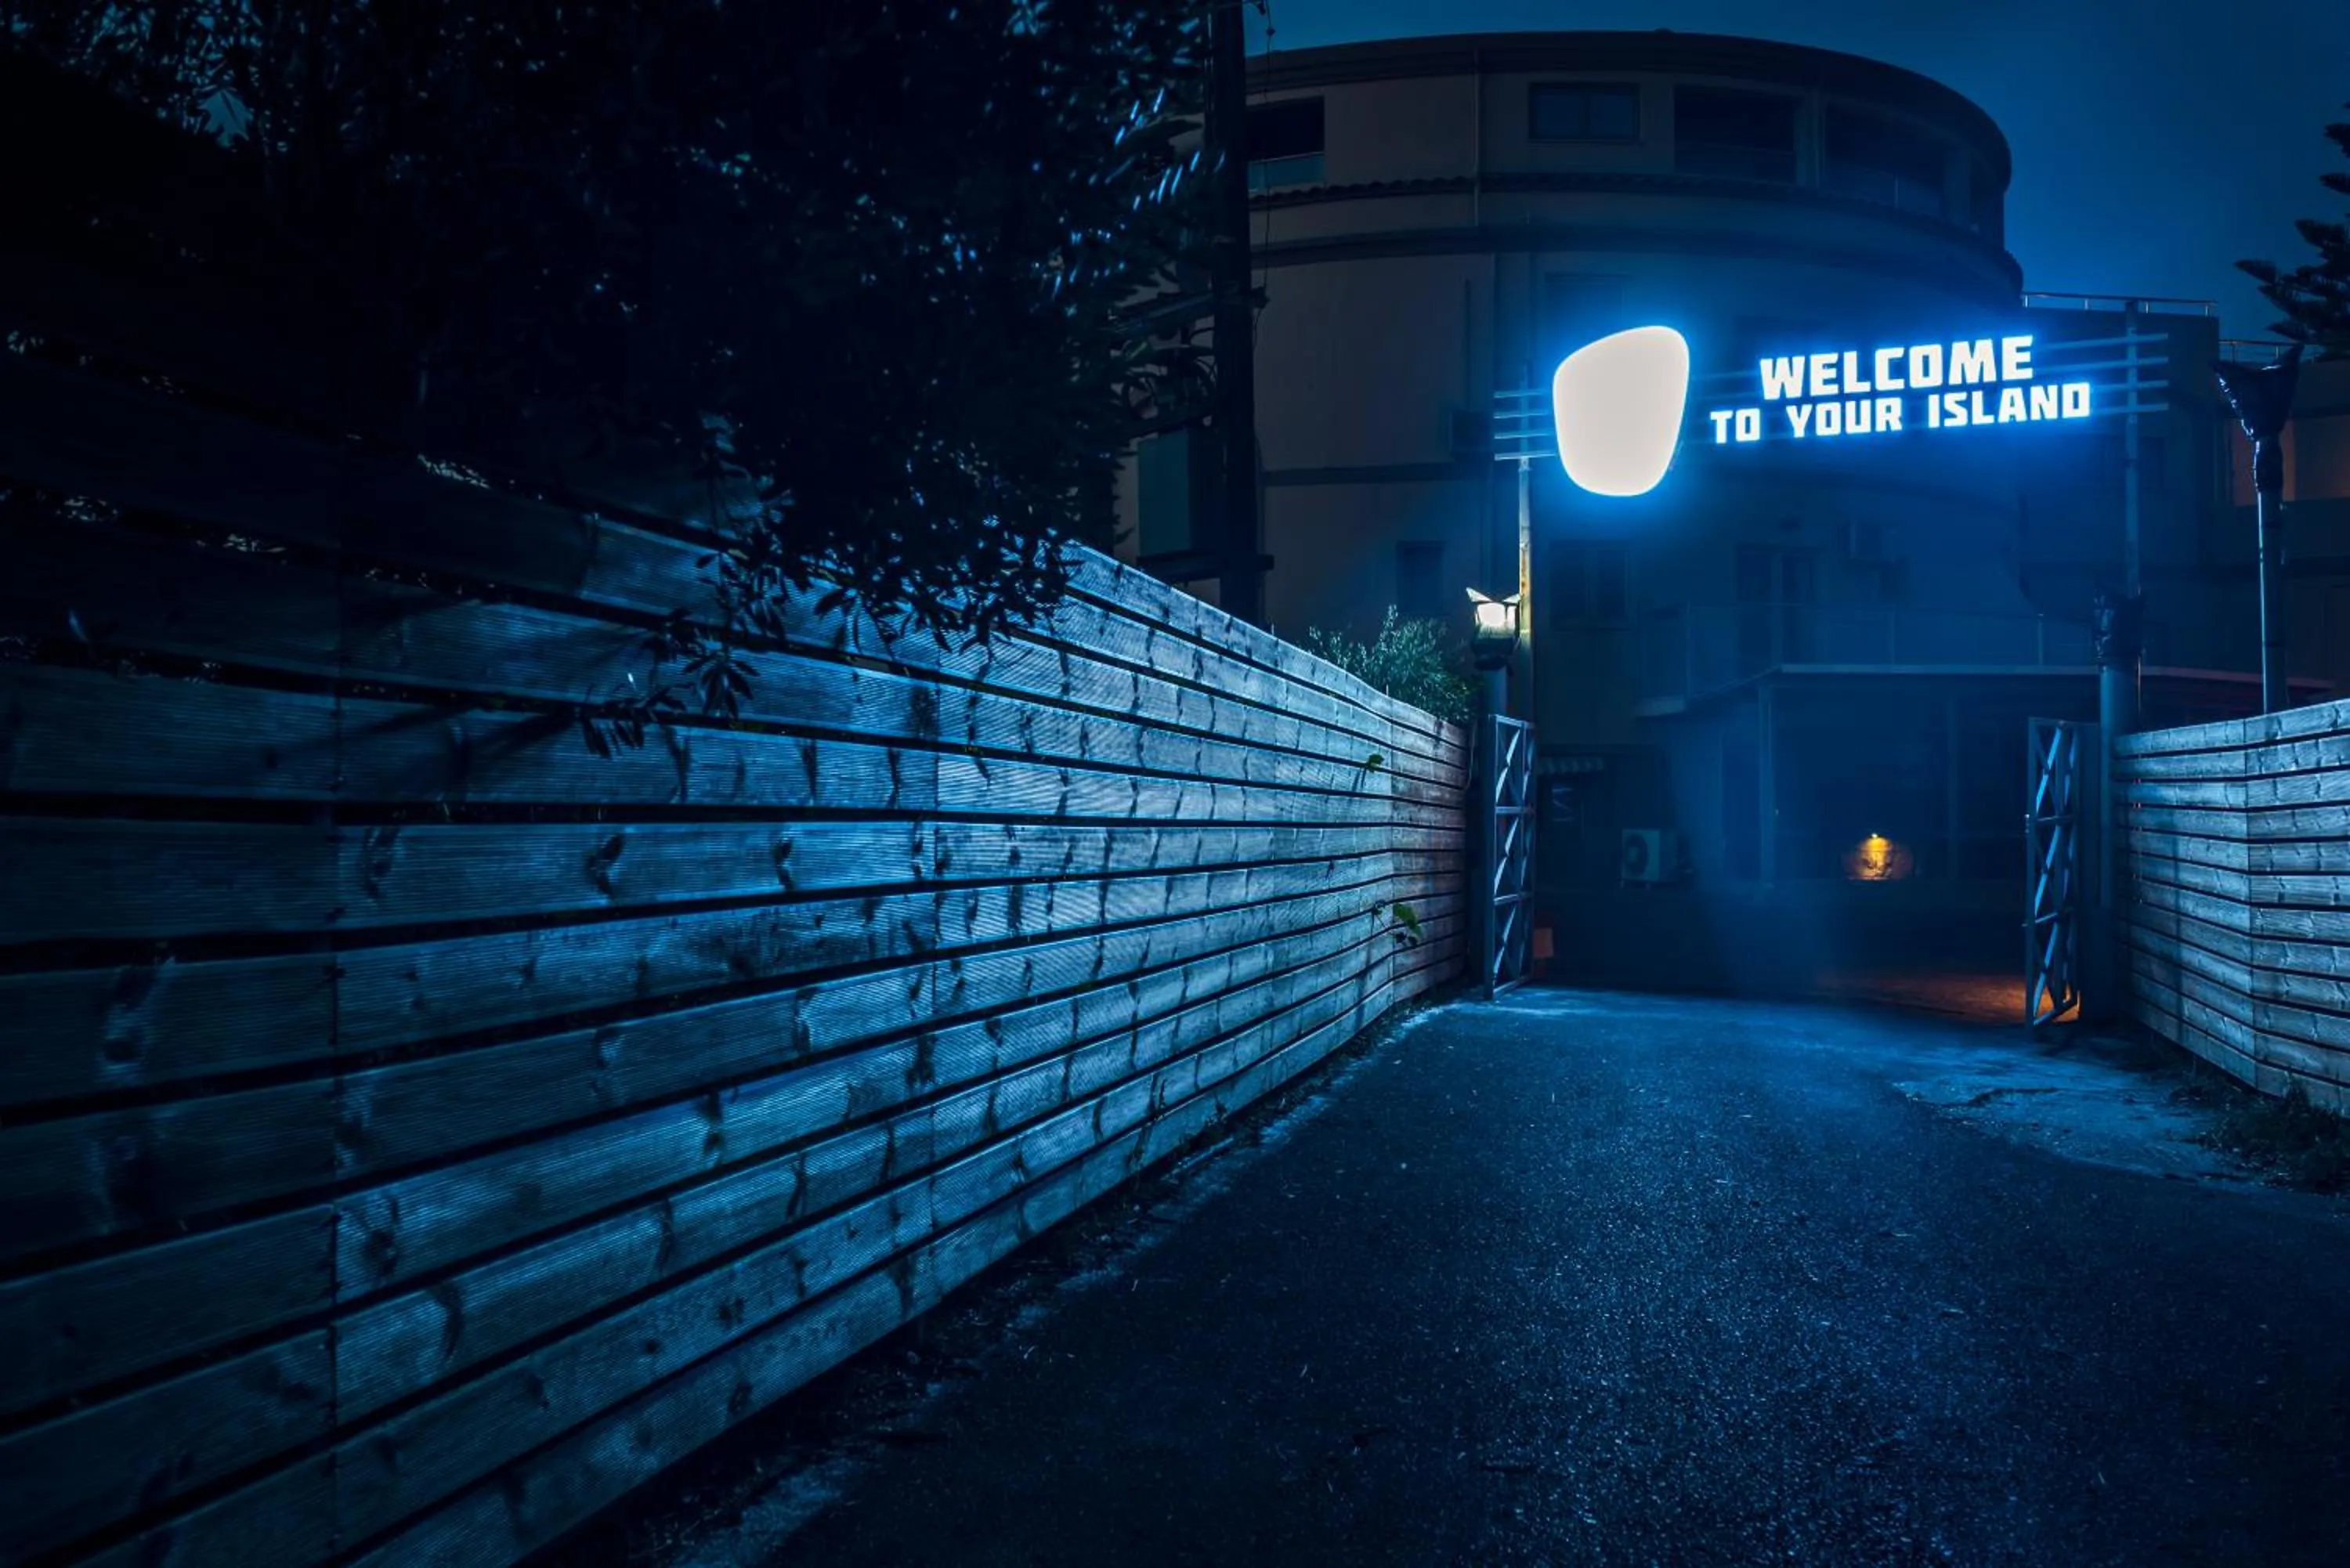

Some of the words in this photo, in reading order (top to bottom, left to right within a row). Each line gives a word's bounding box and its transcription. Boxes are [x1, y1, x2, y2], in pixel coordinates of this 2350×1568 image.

[1759, 336, 2034, 400] WELCOME
[1709, 408, 1760, 444] TO
[1786, 397, 1903, 439] YOUR
[1928, 381, 2091, 428] ISLAND
